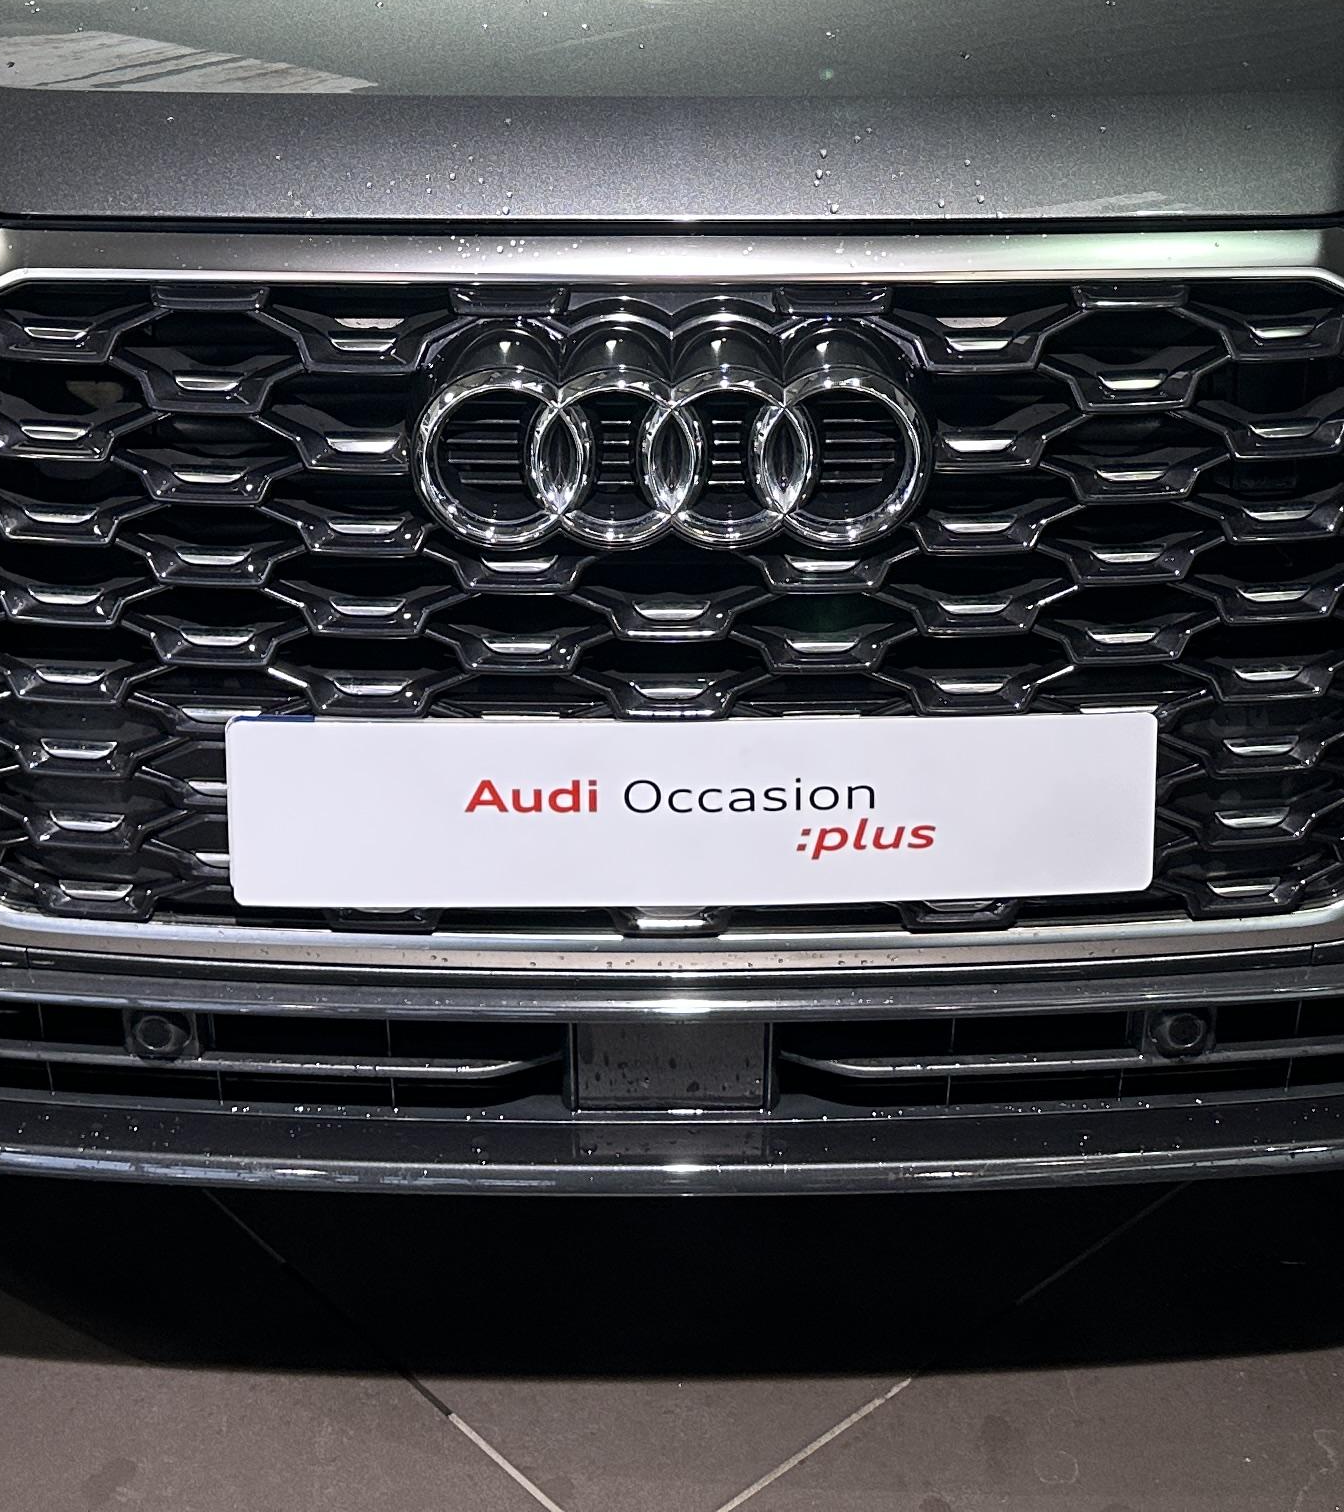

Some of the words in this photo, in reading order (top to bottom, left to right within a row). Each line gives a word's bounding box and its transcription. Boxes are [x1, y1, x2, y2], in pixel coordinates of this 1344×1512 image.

[465, 777, 598, 815] Audi
[623, 777, 877, 815] Occasion
[795, 818, 937, 861] :plus
